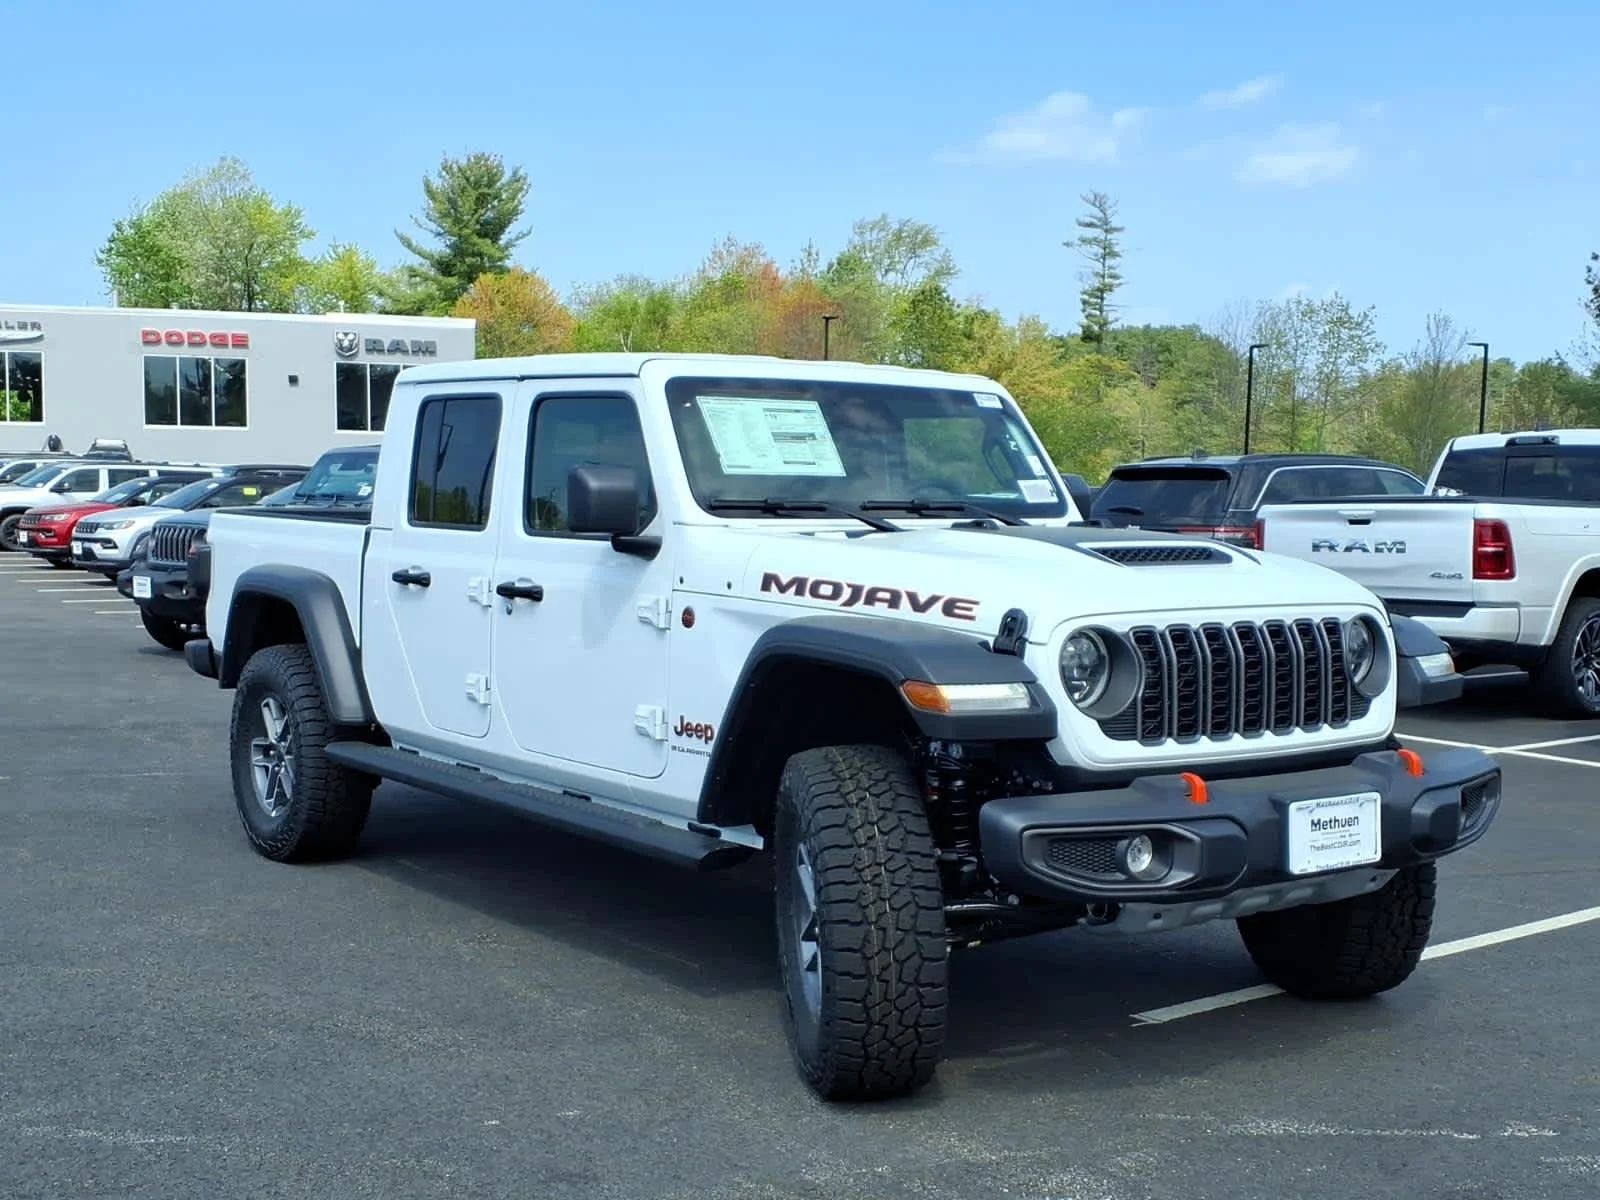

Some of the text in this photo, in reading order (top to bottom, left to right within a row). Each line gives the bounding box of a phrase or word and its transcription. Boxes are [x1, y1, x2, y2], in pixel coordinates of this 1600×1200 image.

[0, 319, 42, 331] LER
[141, 329, 249, 350] DODGE
[364, 338, 437, 356] RAM
[1311, 539, 1407, 554] RAM
[760, 572, 980, 621] MOJAVE
[673, 714, 714, 745] Jeep
[1310, 815, 1360, 832] Methuen
